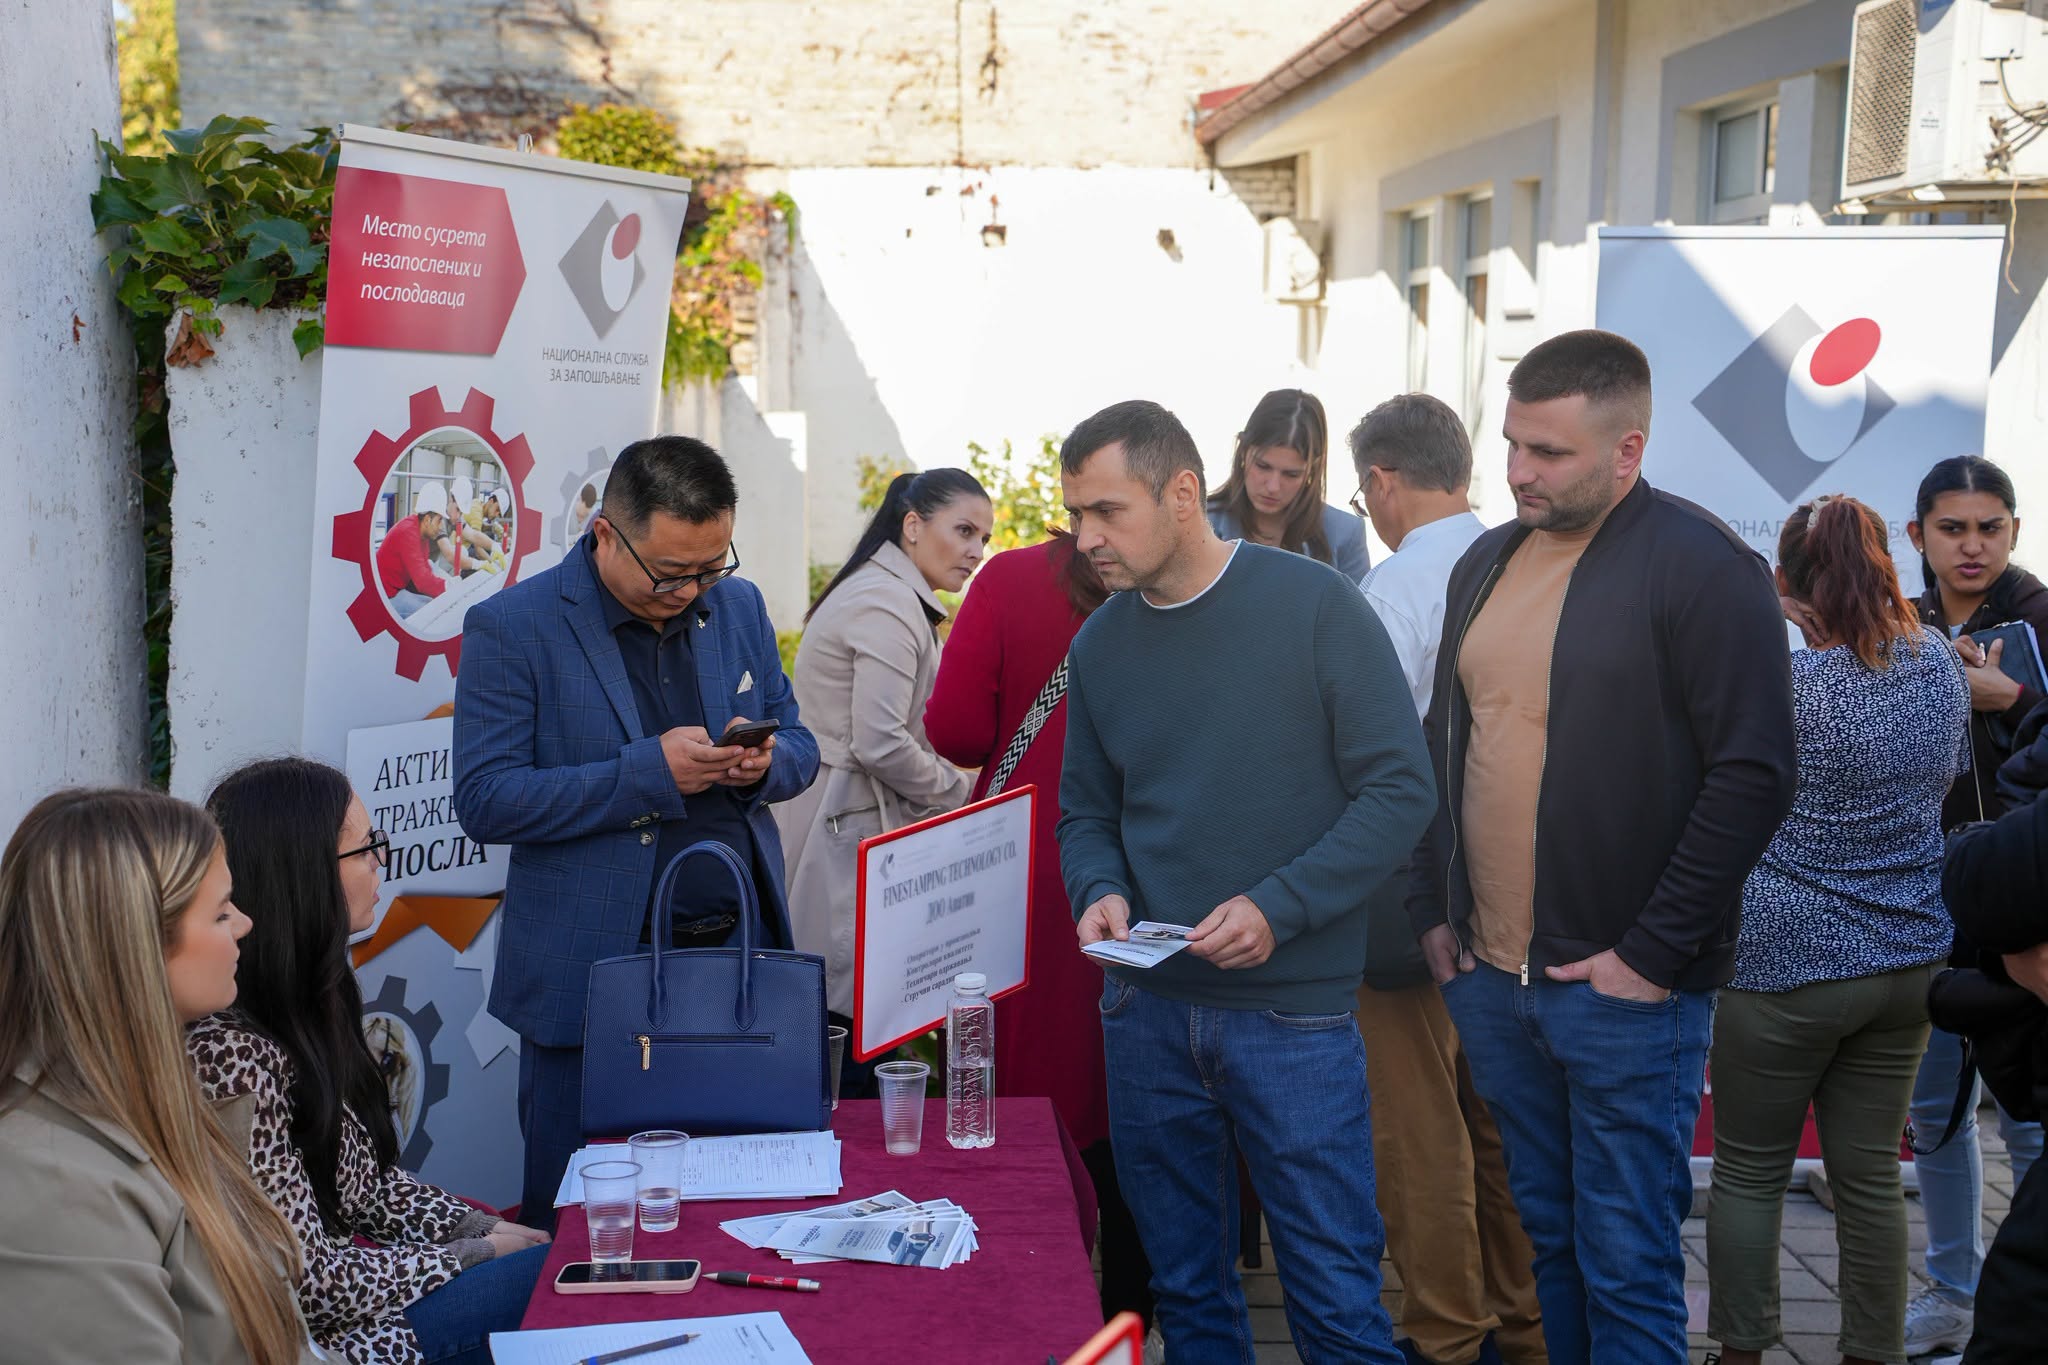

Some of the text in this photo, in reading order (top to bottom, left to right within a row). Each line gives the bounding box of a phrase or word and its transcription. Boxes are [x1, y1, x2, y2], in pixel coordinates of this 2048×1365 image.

[361, 213, 487, 248] Место сусрета
[361, 251, 482, 278] незапослених и
[360, 282, 466, 310] послодаваца
[542, 347, 649, 367] НАЦИОНАЛНА СЛУЖБА
[550, 368, 641, 386] ЗА ЗАПОШЉАВАЊЕ
[373, 748, 453, 792] АКТИ
[374, 795, 459, 835] ТРАЖЕ
[384, 835, 488, 883] ПОСЛА
[883, 866, 947, 909] FINESTAMPING
[949, 845, 1003, 884] TECHNOLOGY
